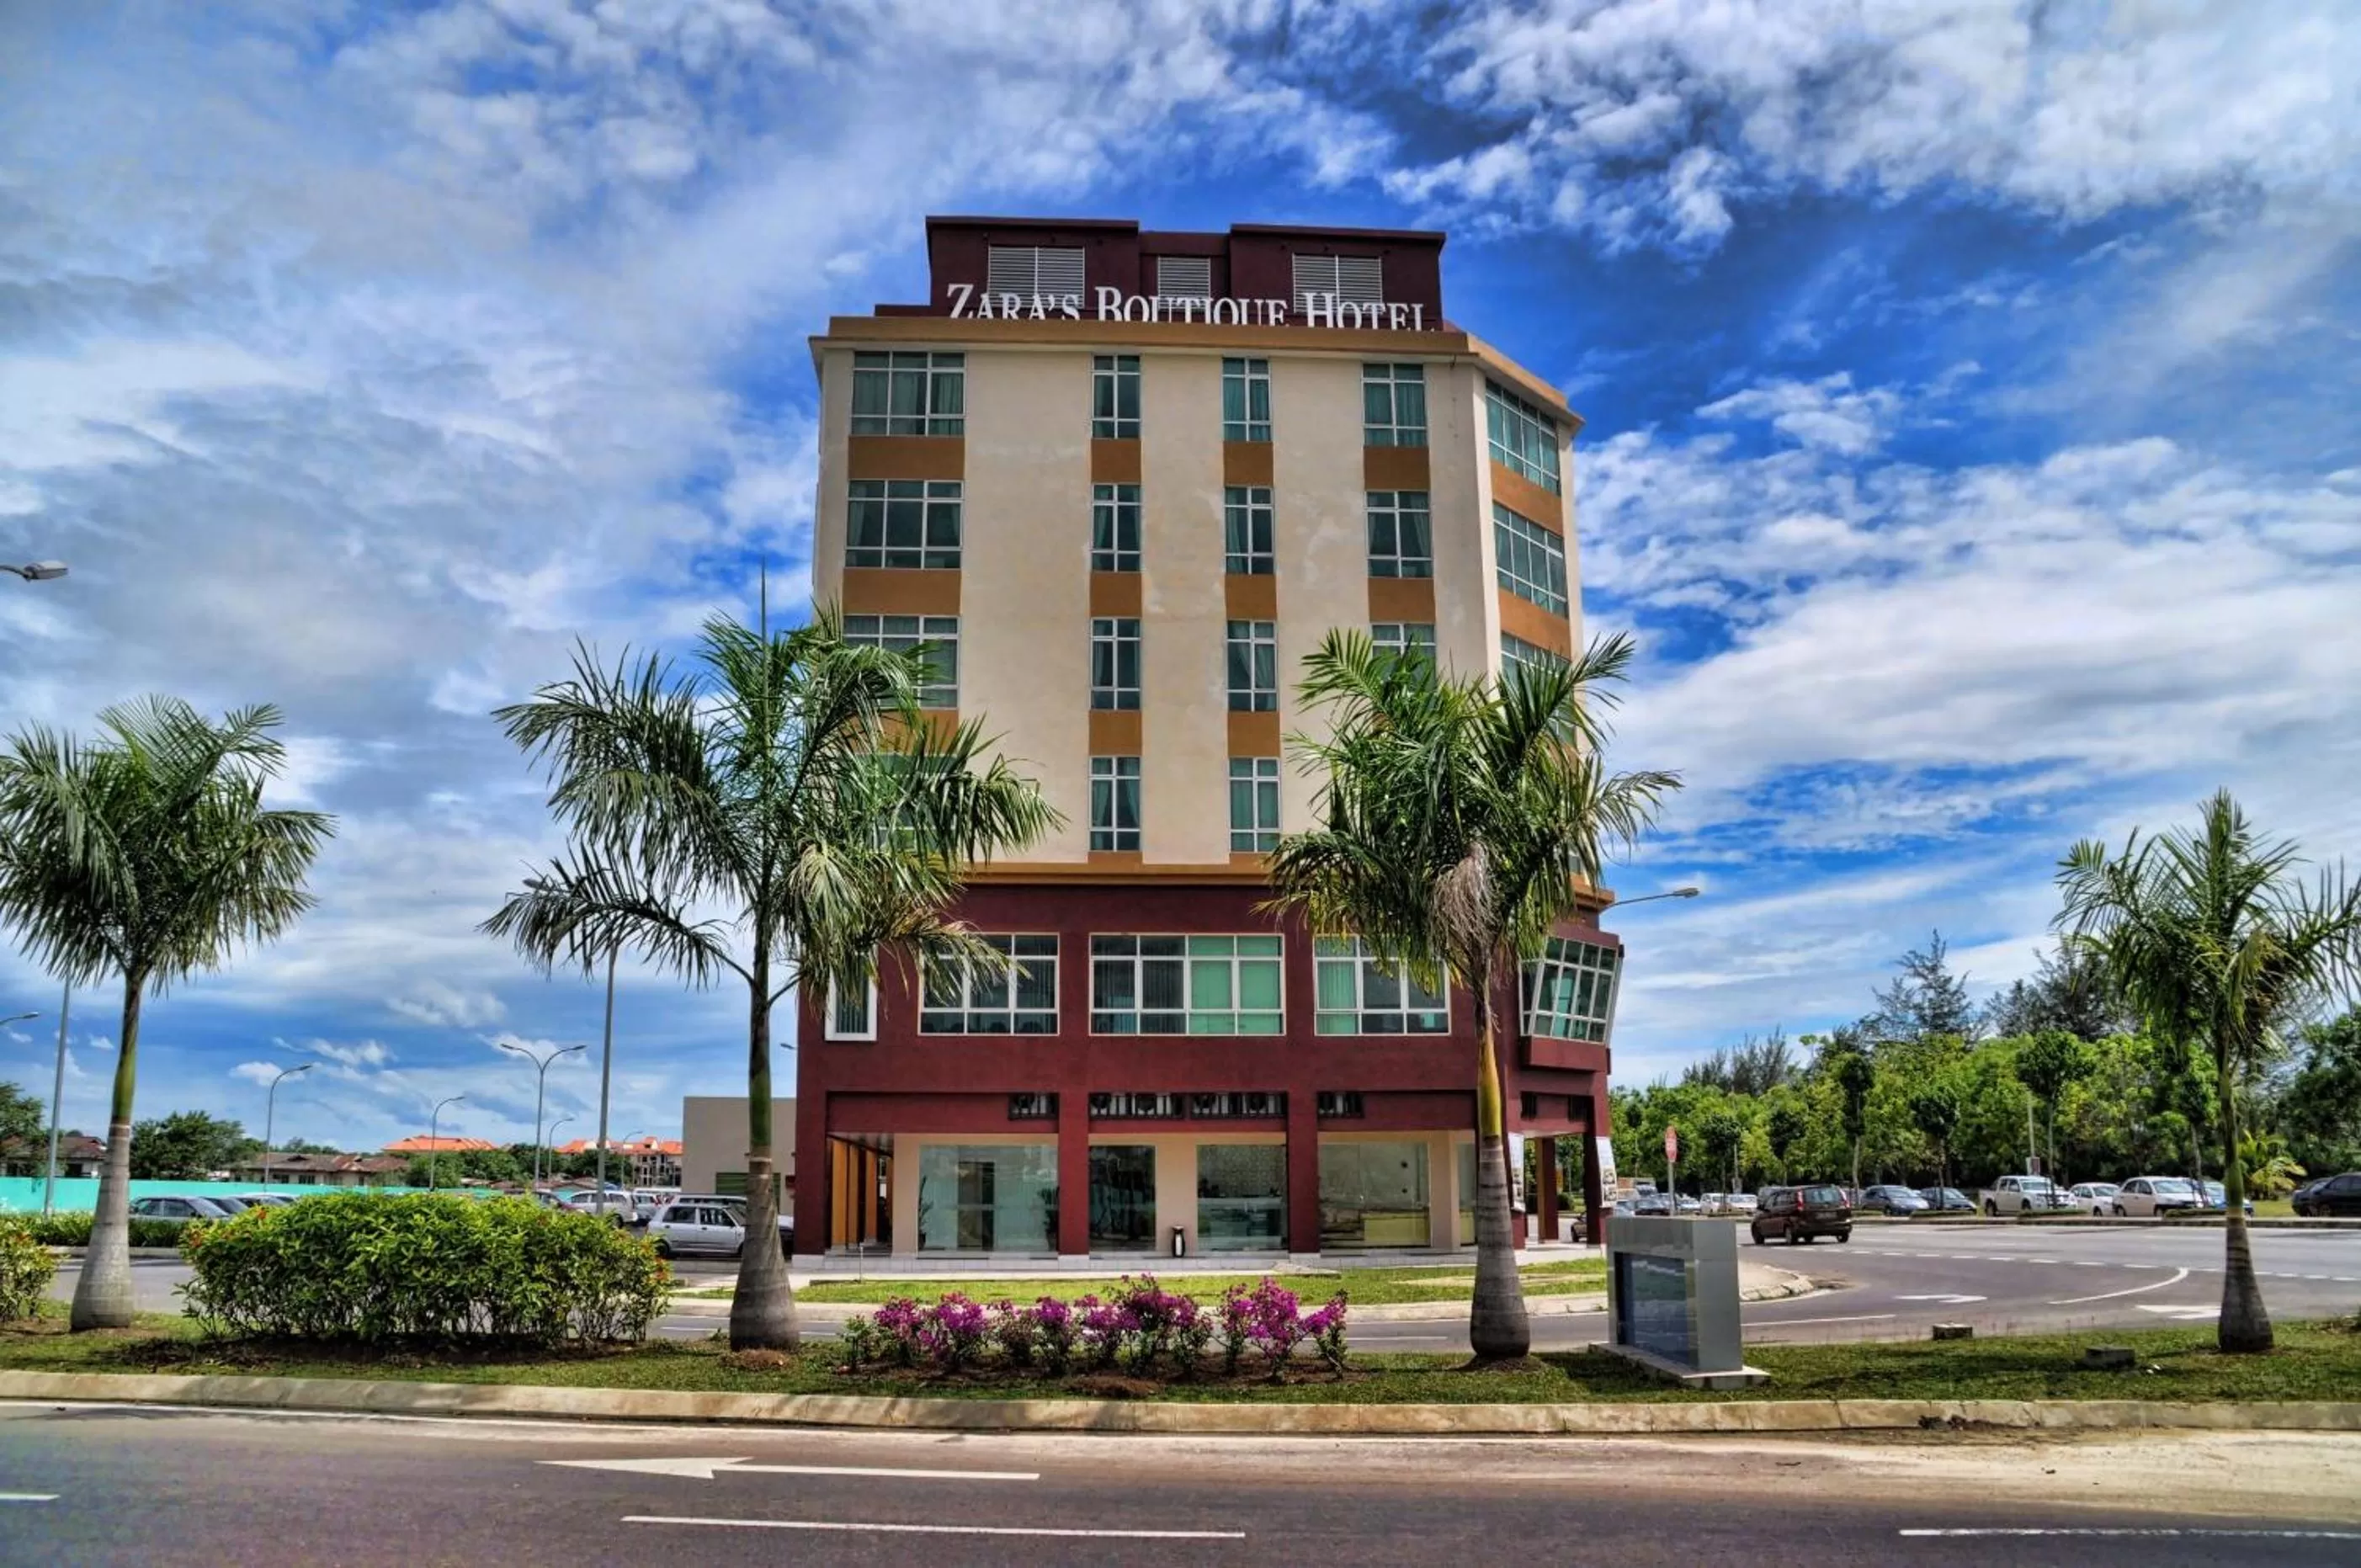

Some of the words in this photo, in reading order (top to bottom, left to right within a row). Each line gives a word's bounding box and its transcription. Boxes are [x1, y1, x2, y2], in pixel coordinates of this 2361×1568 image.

[947, 283, 1081, 321] ZARA'S
[1095, 286, 1290, 327] BOUTIQUE
[1301, 292, 1434, 332] HOTEL
